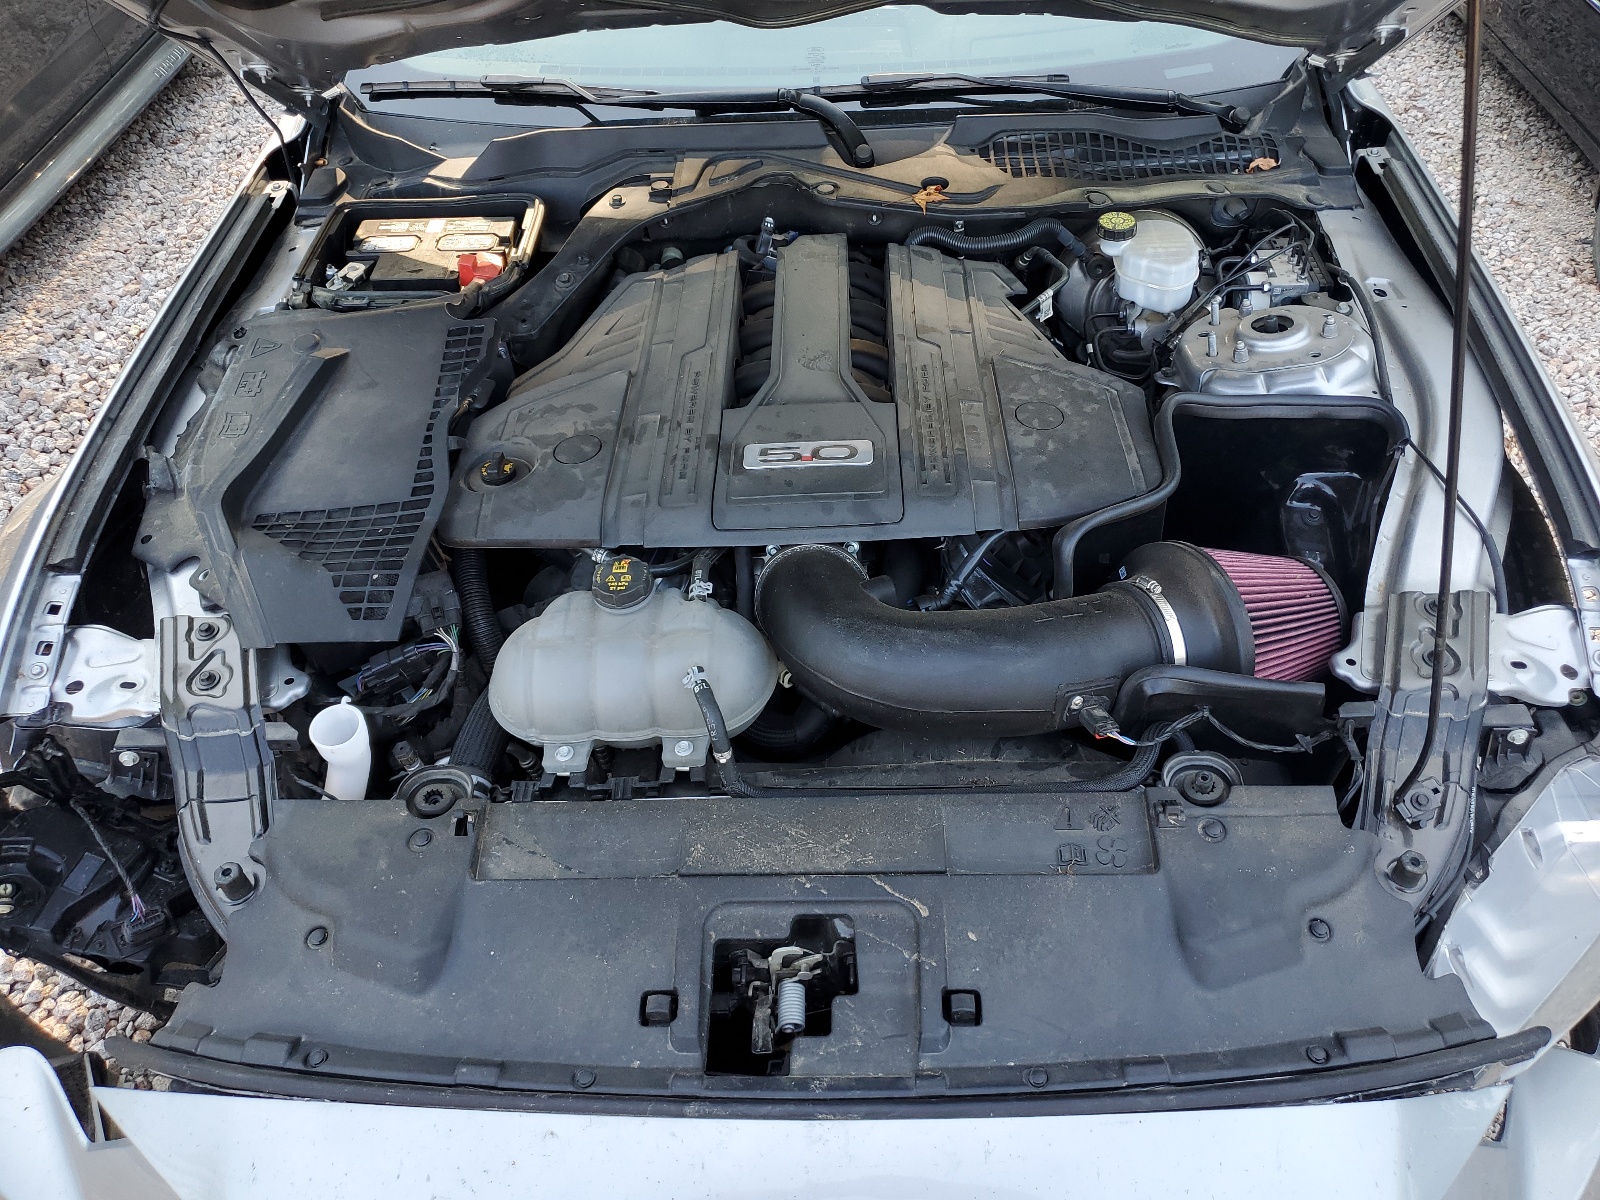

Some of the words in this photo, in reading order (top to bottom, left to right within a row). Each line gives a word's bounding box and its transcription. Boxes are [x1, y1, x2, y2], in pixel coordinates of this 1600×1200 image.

[920, 364, 931, 392] FORD
[921, 395, 933, 412] BY
[684, 428, 694, 443] BY
[758, 444, 859, 463] 5.0
